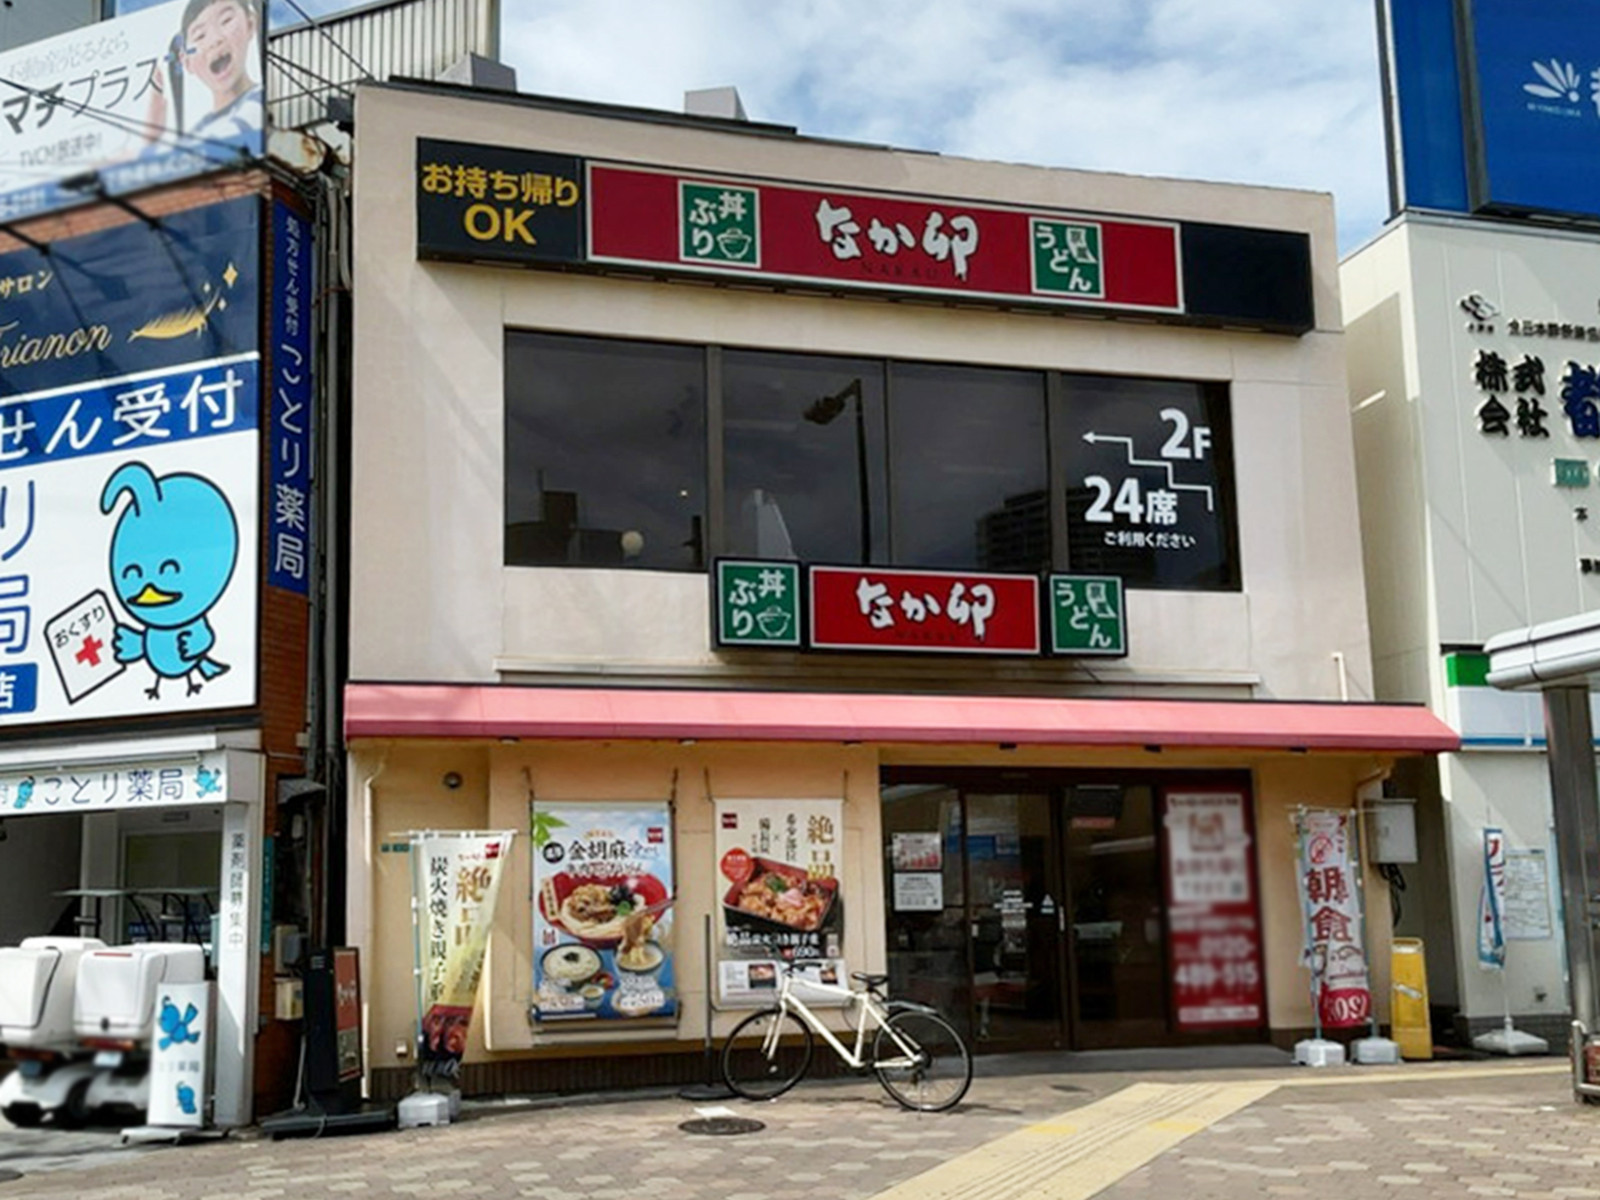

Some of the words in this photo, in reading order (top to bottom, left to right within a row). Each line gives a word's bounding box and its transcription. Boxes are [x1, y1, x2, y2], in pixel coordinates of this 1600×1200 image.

[2, 58, 163, 134] マチプラス
[421, 163, 580, 207] お持ち帰り
[464, 204, 537, 245] OK
[815, 199, 979, 282] なか卯
[1035, 224, 1093, 292] うどん
[1159, 408, 1212, 459] 2F
[271, 343, 306, 579] ことり薬局
[1083, 475, 1179, 526] 24席
[1103, 531, 1196, 549] ご利用ください
[54, 605, 106, 649] おくすり
[856, 576, 996, 643] なか卯
[1055, 582, 1112, 648] うどん
[43, 767, 184, 806] ことり薬局
